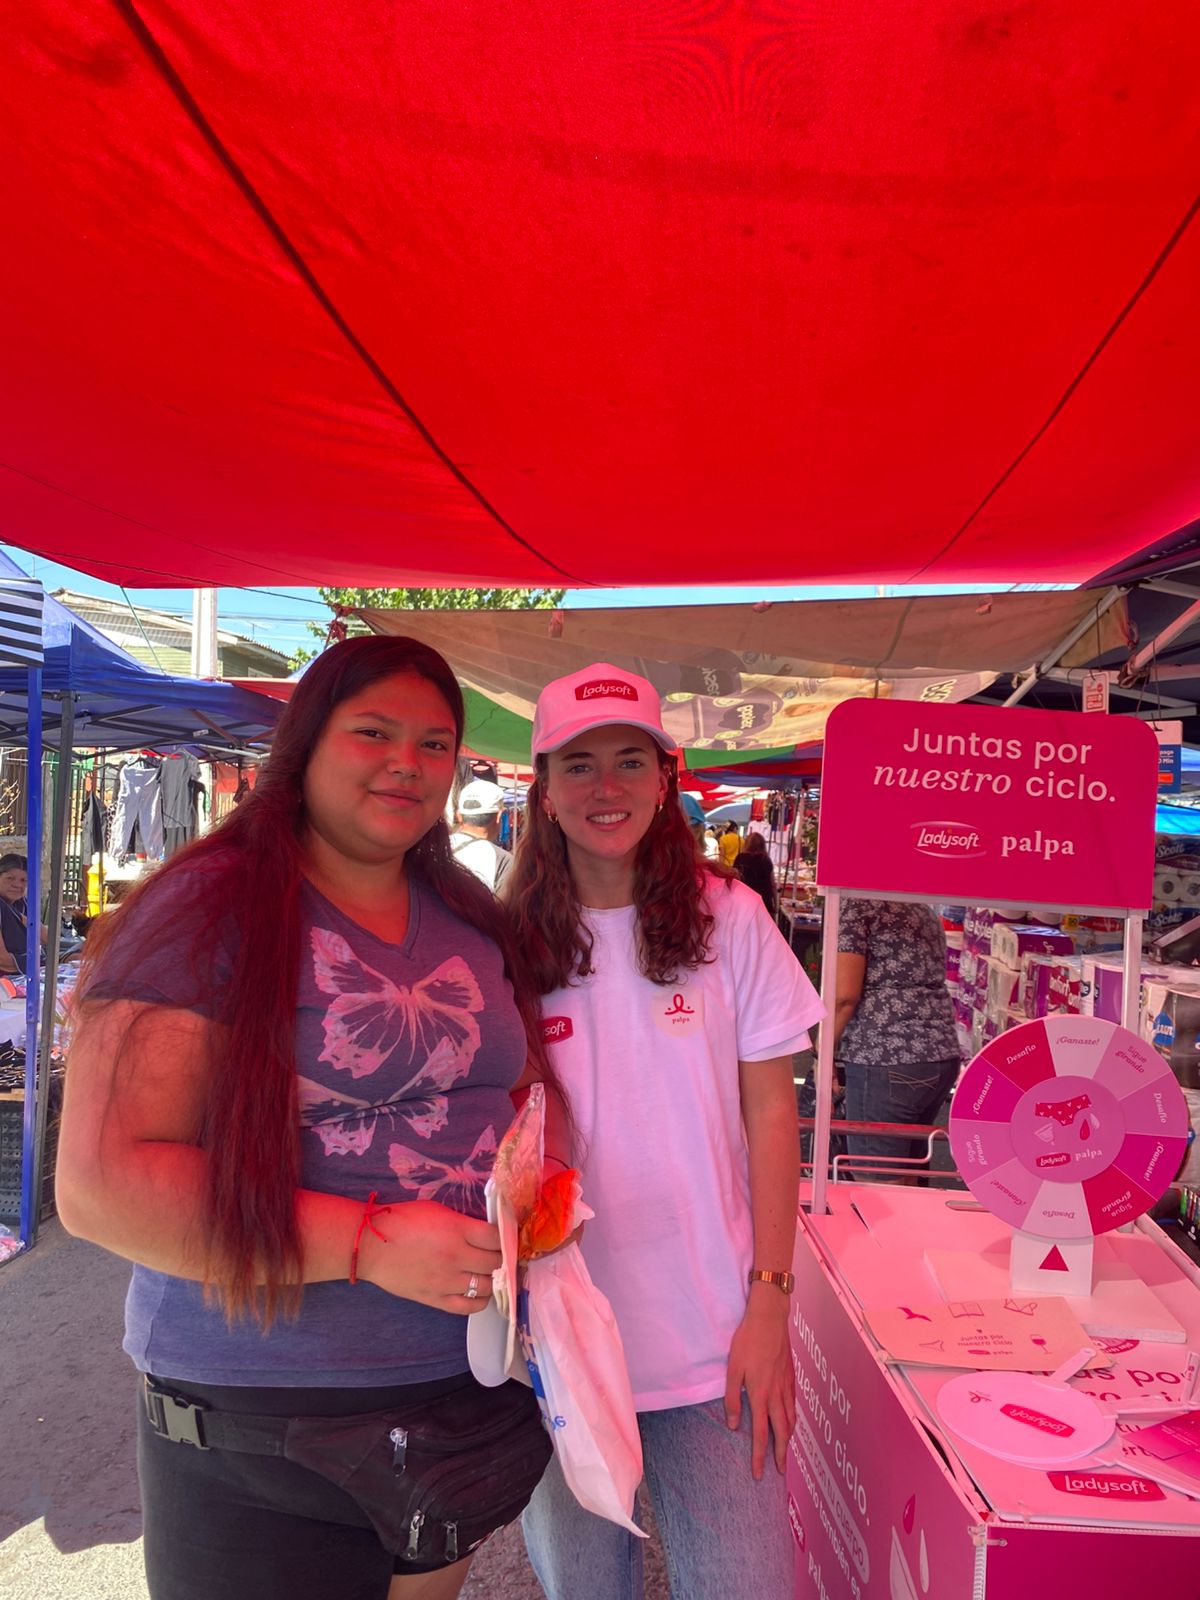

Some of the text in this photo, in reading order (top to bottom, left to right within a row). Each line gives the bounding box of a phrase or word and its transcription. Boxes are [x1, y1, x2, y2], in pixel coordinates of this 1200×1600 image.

[582, 684, 631, 698] Ladysoft
[903, 728, 1092, 769] Juntas por
[873, 765, 1115, 802] nuestro ciclo.
[917, 828, 980, 849] Ladysoft
[1001, 831, 1075, 860] palpa
[1156, 843, 1185, 858] Scott
[543, 1020, 567, 1036] soft
[672, 1017, 690, 1025] palpa
[1056, 1036, 1100, 1046] ¡Ganaste!
[1115, 1050, 1145, 1073] girando
[1127, 1046, 1147, 1063] Sigue
[973, 1075, 994, 1115] ¡Ganaste!
[973, 1134, 988, 1166] girando
[1075, 1149, 1103, 1161] palpa
[1143, 1141, 1165, 1182] ¡Ganaste!
[990, 1179, 1027, 1207] ¡Ganaste!
[1102, 1190, 1132, 1213] girando
[1111, 1203, 1133, 1217] Sigue
[794, 1302, 852, 1424] Juntas por
[1126, 1369, 1187, 1388] po
[1010, 1408, 1068, 1433] Ladysoft
[792, 1348, 870, 1527] nuestro ciclo.
[1065, 1475, 1149, 1495] Ladysoft
[789, 1435, 819, 1509] scucharlo
[820, 1500, 850, 1581] también
[808, 1552, 830, 1600] palp
